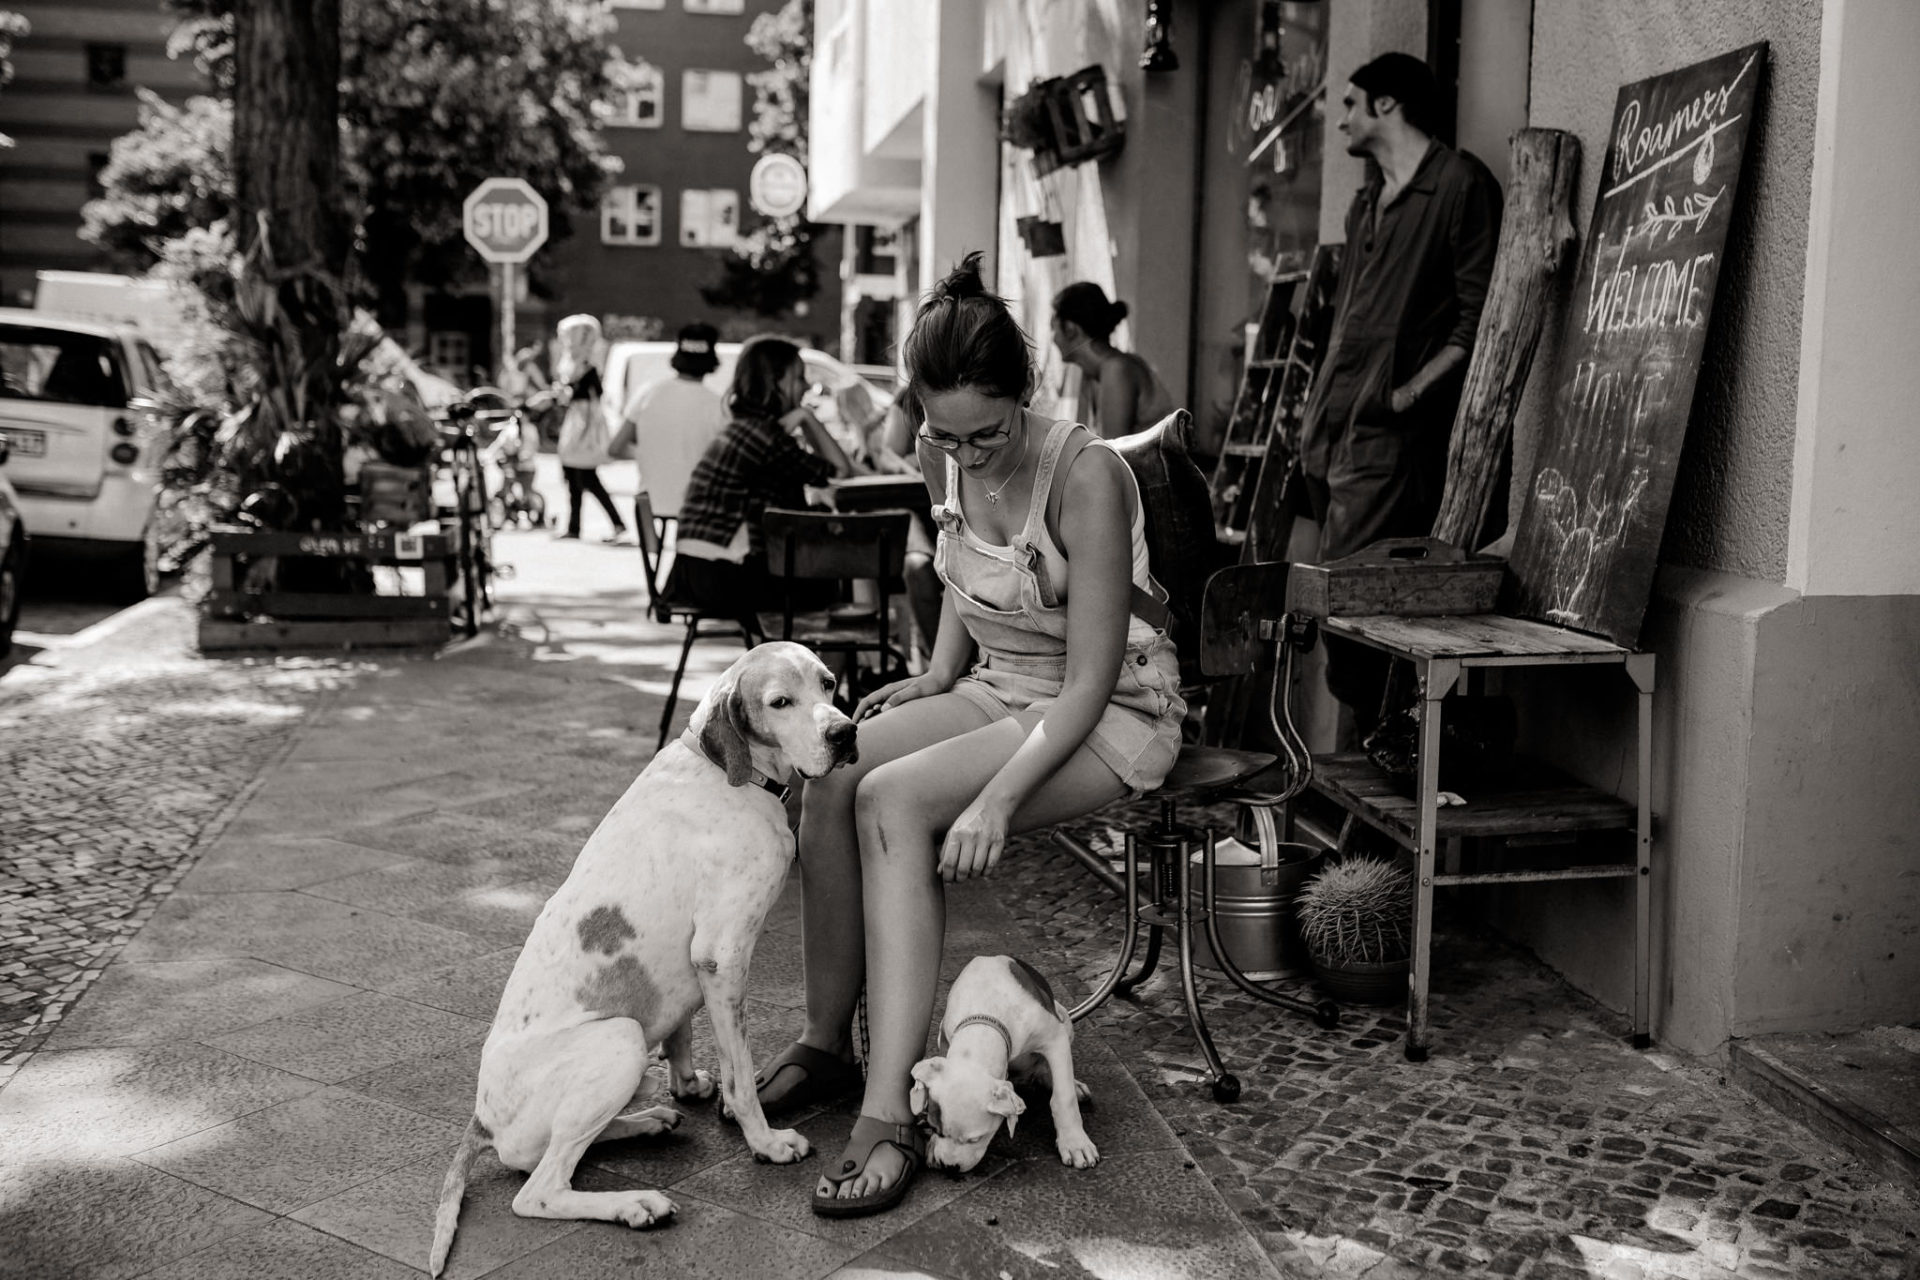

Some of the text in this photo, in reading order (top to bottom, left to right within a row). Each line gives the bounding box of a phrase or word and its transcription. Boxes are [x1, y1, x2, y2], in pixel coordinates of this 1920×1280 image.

[1612, 70, 1742, 181] Roamers
[473, 202, 538, 238] STOP
[1583, 226, 1714, 334] WELCOME
